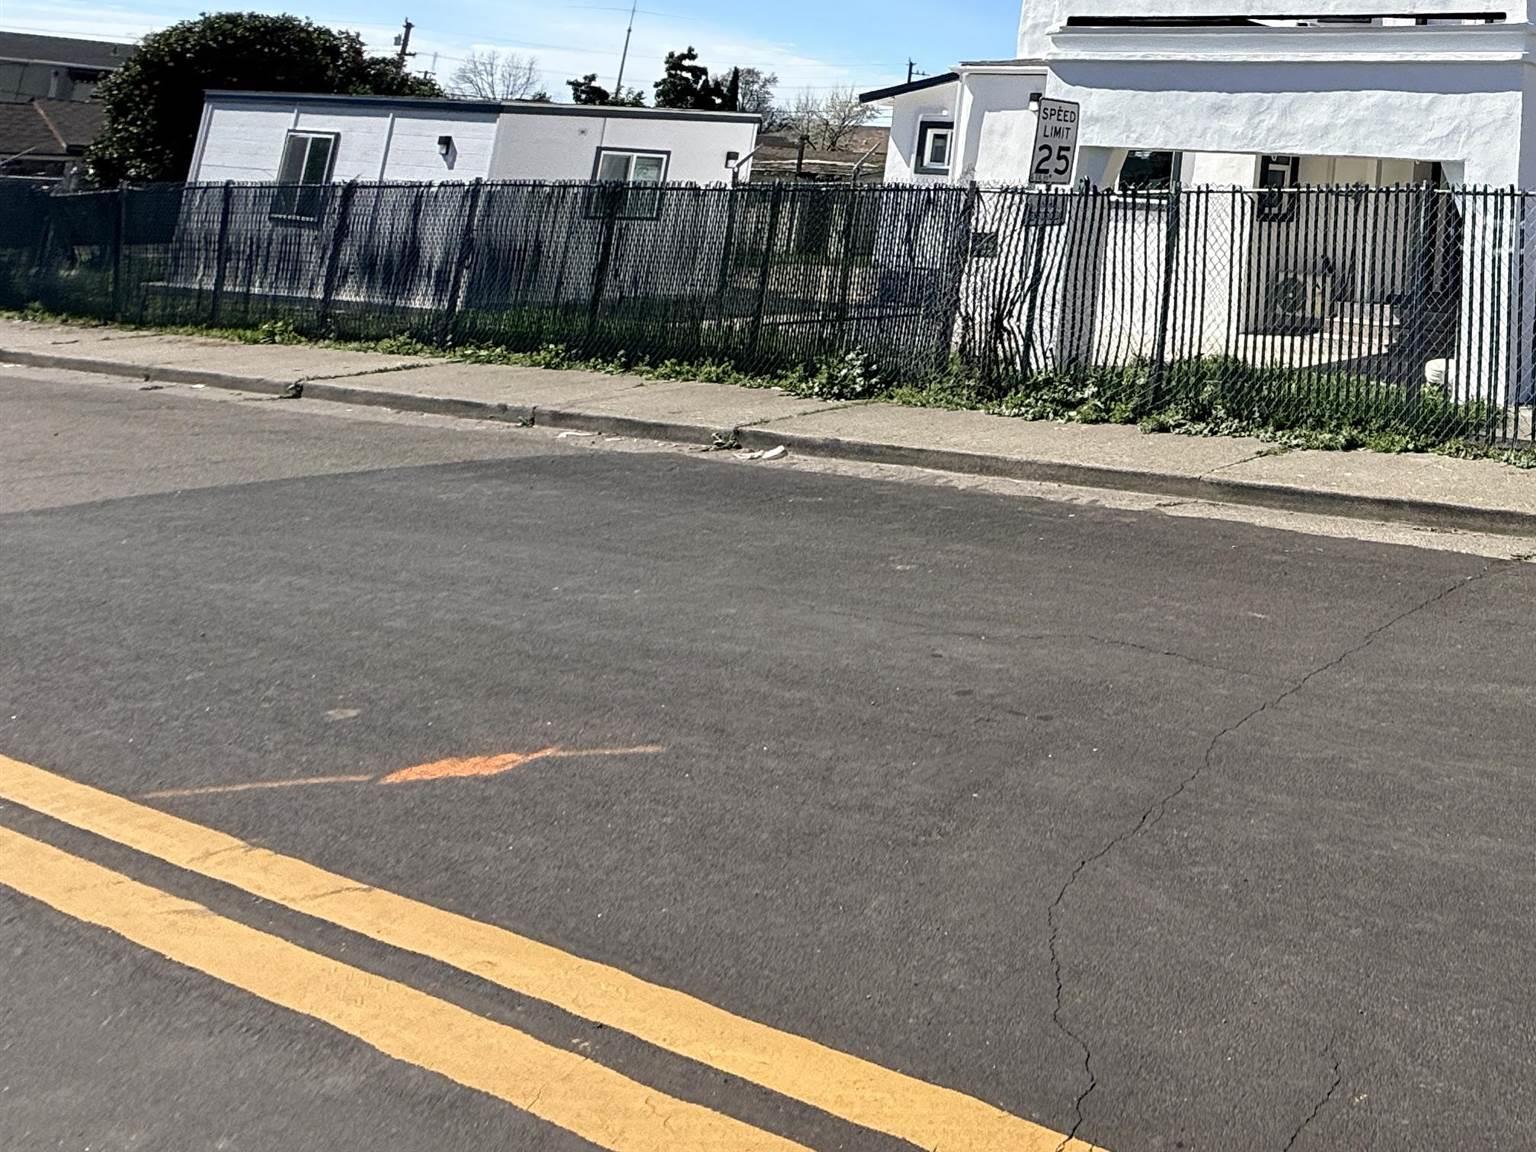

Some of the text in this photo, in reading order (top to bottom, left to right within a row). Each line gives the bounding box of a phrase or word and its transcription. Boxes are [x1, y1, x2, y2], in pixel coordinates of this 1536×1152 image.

[1042, 107, 1076, 123] SPEED
[1043, 125, 1071, 139] LIMIT
[1034, 144, 1071, 175] 25
